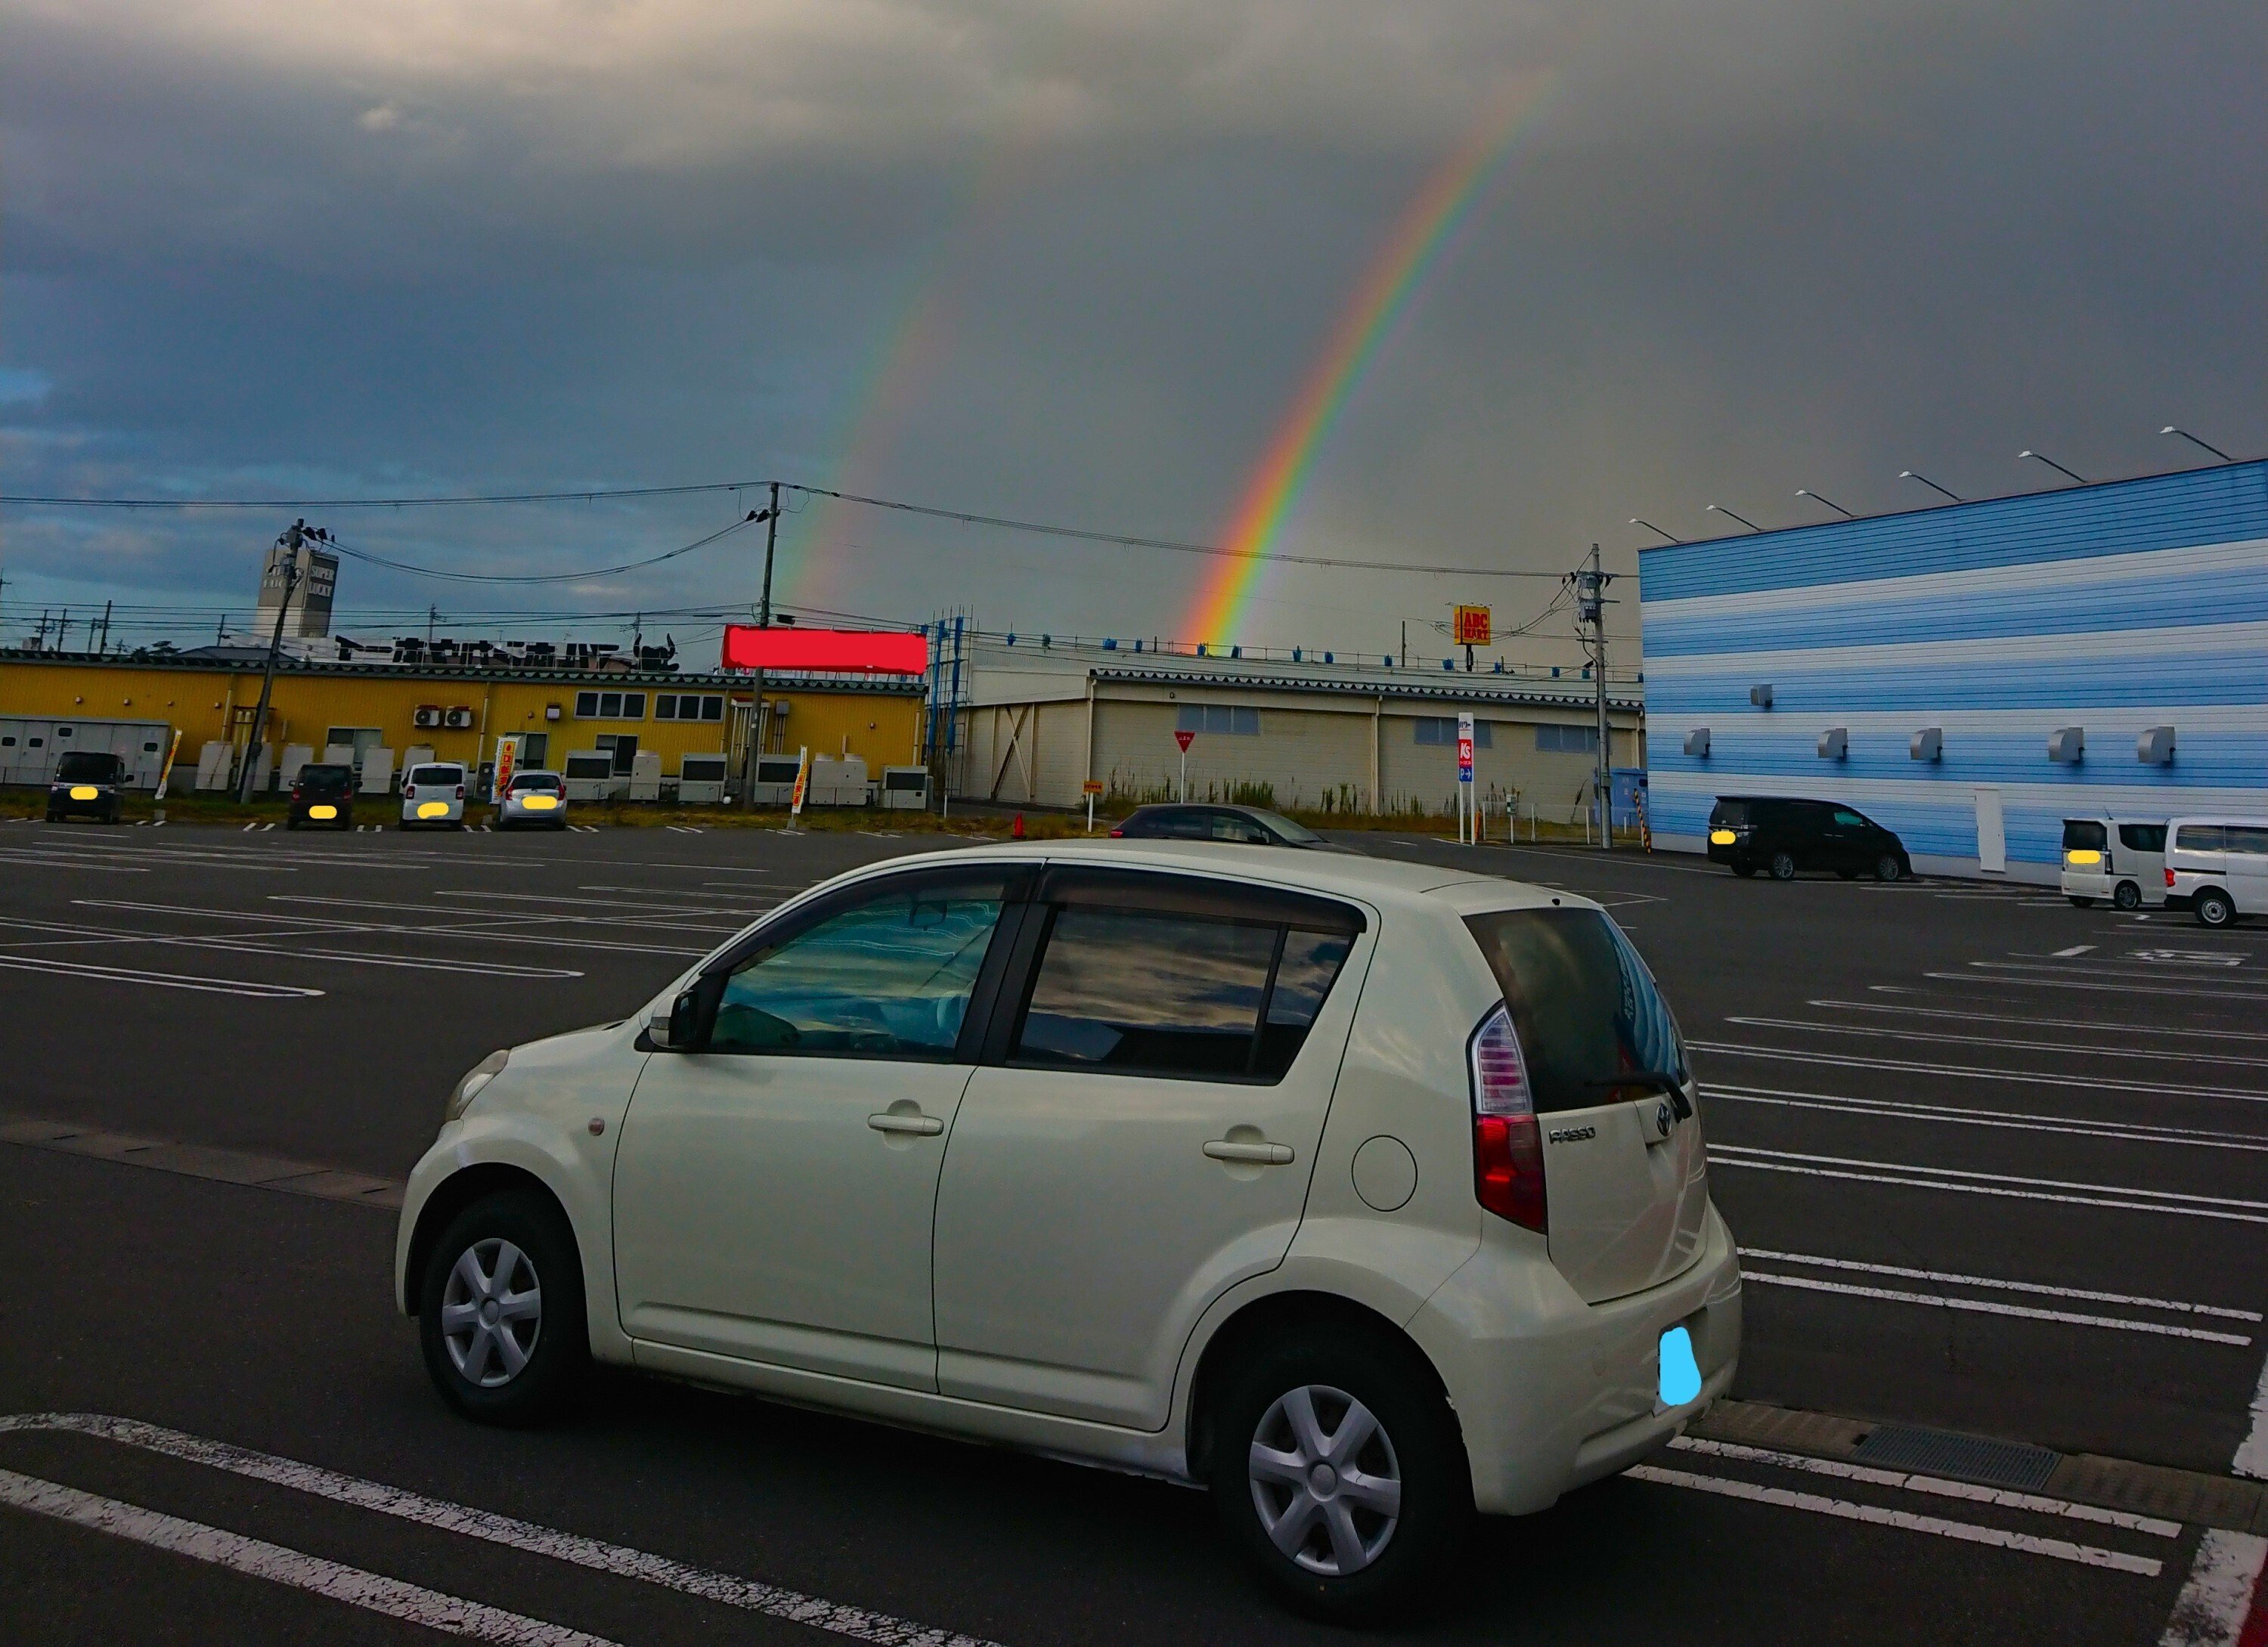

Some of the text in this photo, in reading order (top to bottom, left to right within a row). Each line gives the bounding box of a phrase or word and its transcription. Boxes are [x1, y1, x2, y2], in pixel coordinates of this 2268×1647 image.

[311, 565, 335, 581] SUPER
[307, 581, 333, 597] LUCKY
[1464, 612, 1487, 628] ABC
[1464, 628, 1488, 639] MART
[1460, 768, 1464, 779] P
[1549, 1125, 1596, 1144] PASSO
